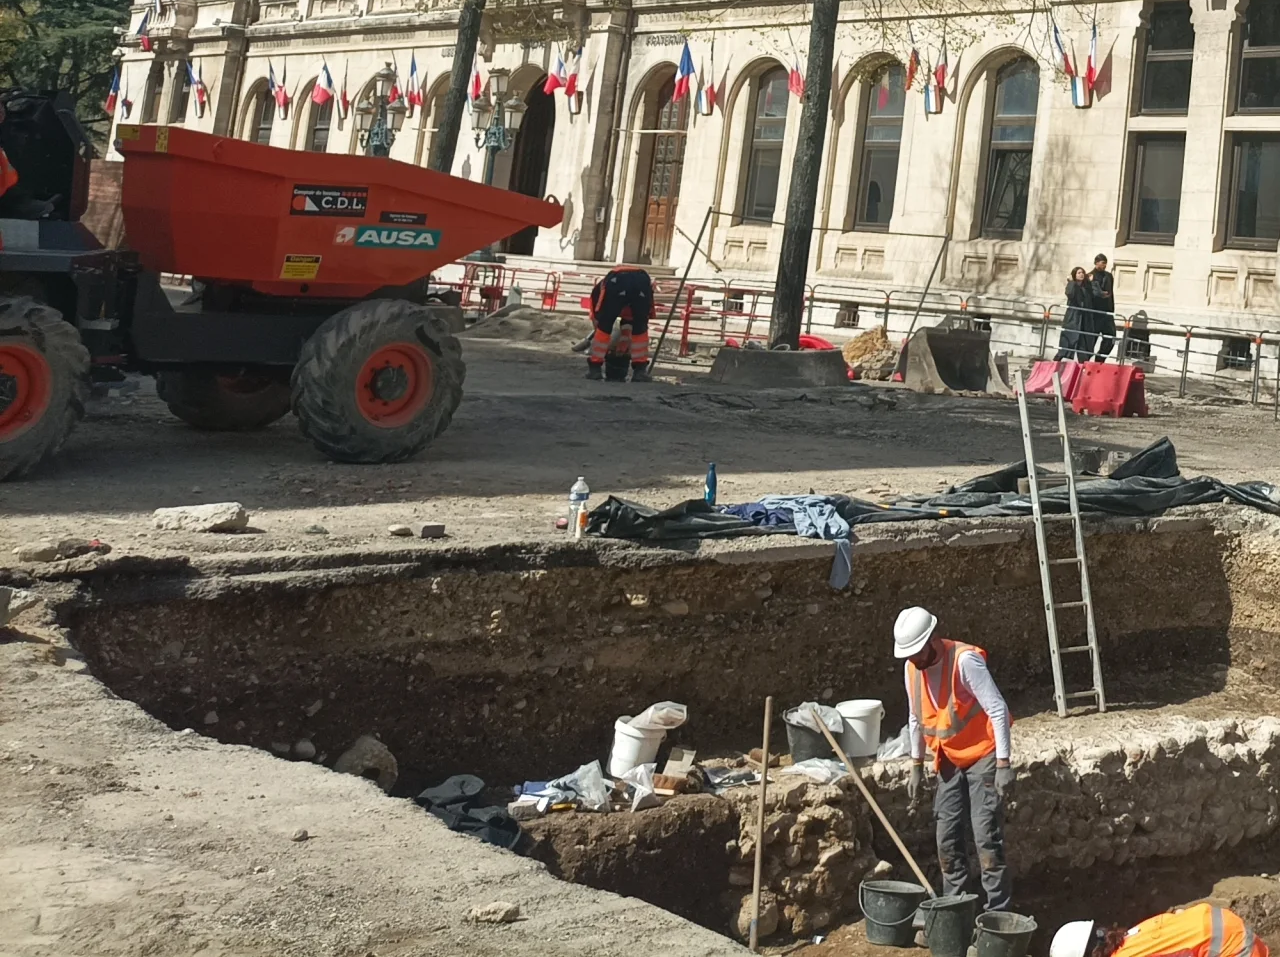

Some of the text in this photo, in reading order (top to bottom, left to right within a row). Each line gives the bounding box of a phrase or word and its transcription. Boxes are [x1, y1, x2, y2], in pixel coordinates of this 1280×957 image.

[646, 34, 687, 47] FRATERNIT
[321, 196, 366, 210] C.D.L.
[357, 229, 435, 246] AUSA
